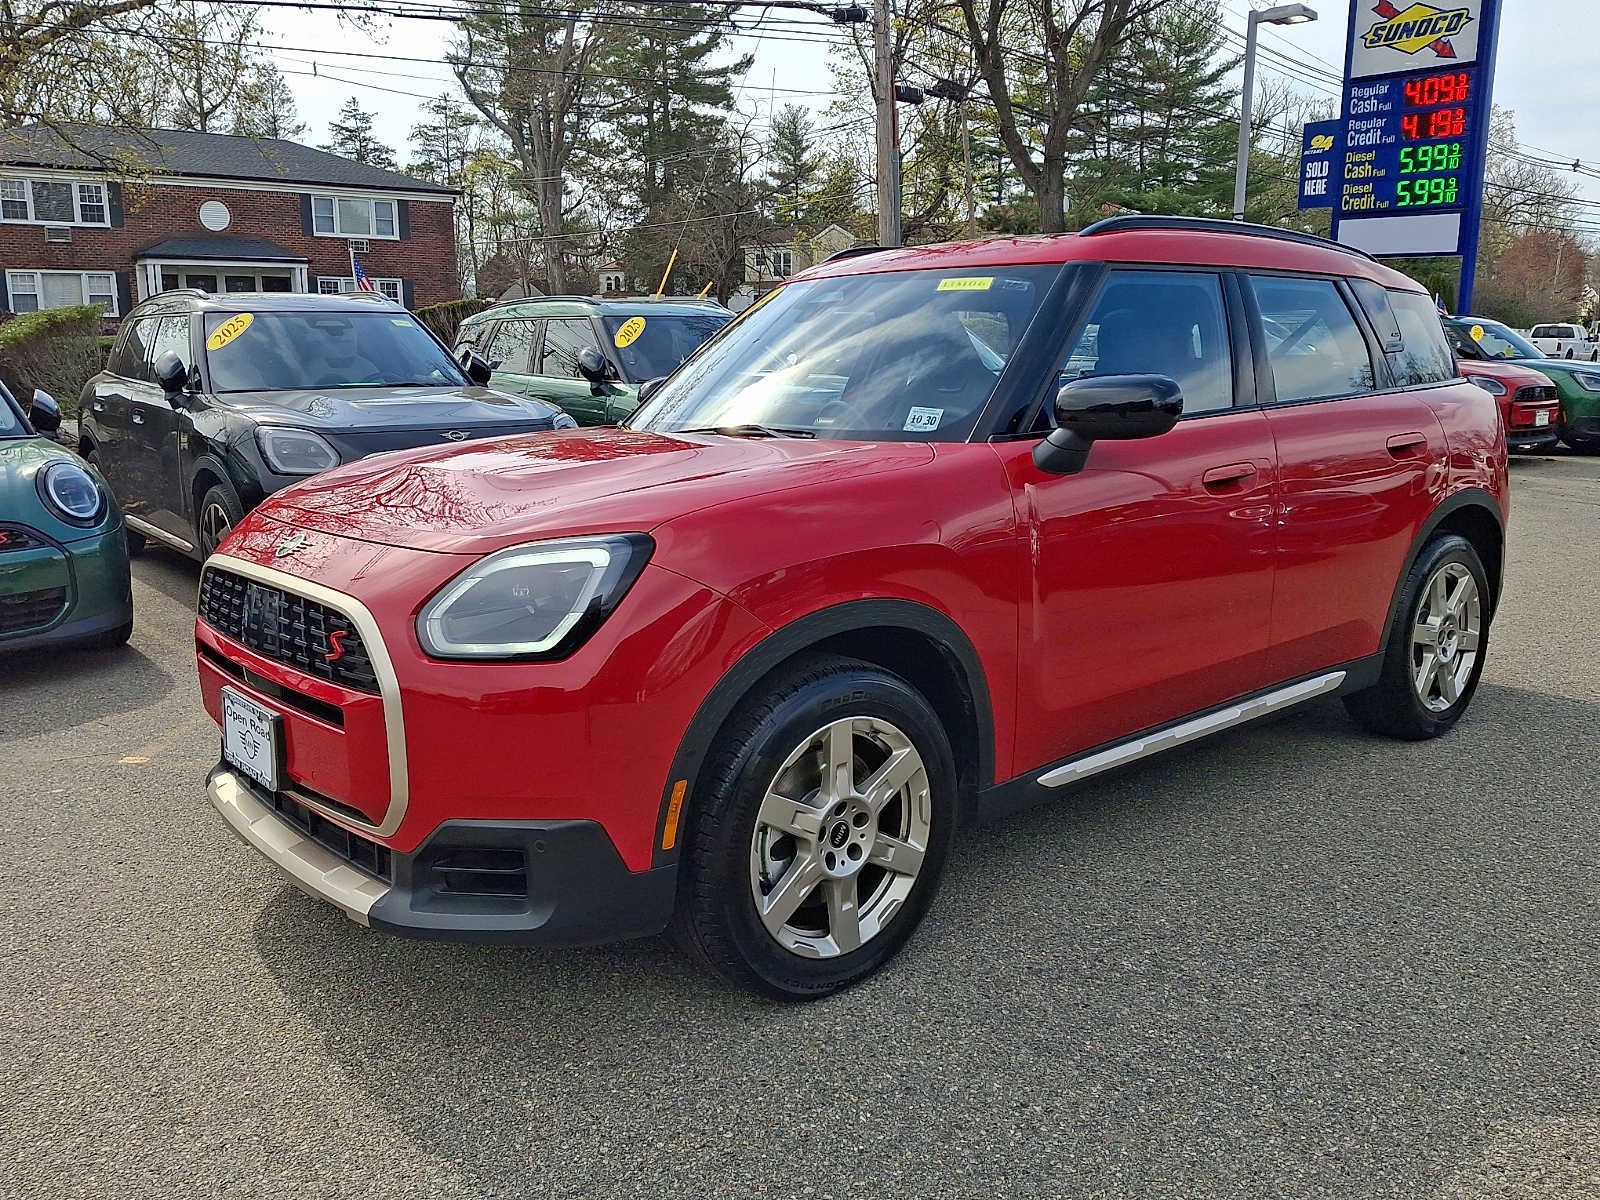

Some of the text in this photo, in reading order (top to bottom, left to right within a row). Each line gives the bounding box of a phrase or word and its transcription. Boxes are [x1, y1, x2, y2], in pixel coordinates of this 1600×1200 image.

[1371, 13, 1464, 44] SUNOCO
[1351, 84, 1390, 99] Regular
[1406, 75, 1455, 105] 4.09
[1350, 96, 1392, 114] Cash Full
[1348, 117, 1387, 131] Regular
[1310, 135, 1334, 150] 94
[1347, 129, 1395, 147] Credit Full
[1345, 150, 1376, 163] Diesel
[1400, 144, 1448, 173] 5.99
[1305, 161, 1329, 178] SOLD
[1344, 162, 1386, 179] Cash Full
[1304, 179, 1328, 196] HERE
[1343, 183, 1373, 194] Diesel
[1397, 178, 1445, 206] 5.99
[1341, 194, 1390, 210] Credit Full
[214, 316, 246, 345] 2025
[619, 319, 641, 343] 2025
[911, 414, 937, 426] 10 30
[324, 630, 348, 662] S
[226, 705, 248, 727] Open
[250, 718, 271, 741] Road
[834, 824, 847, 845] MINI
